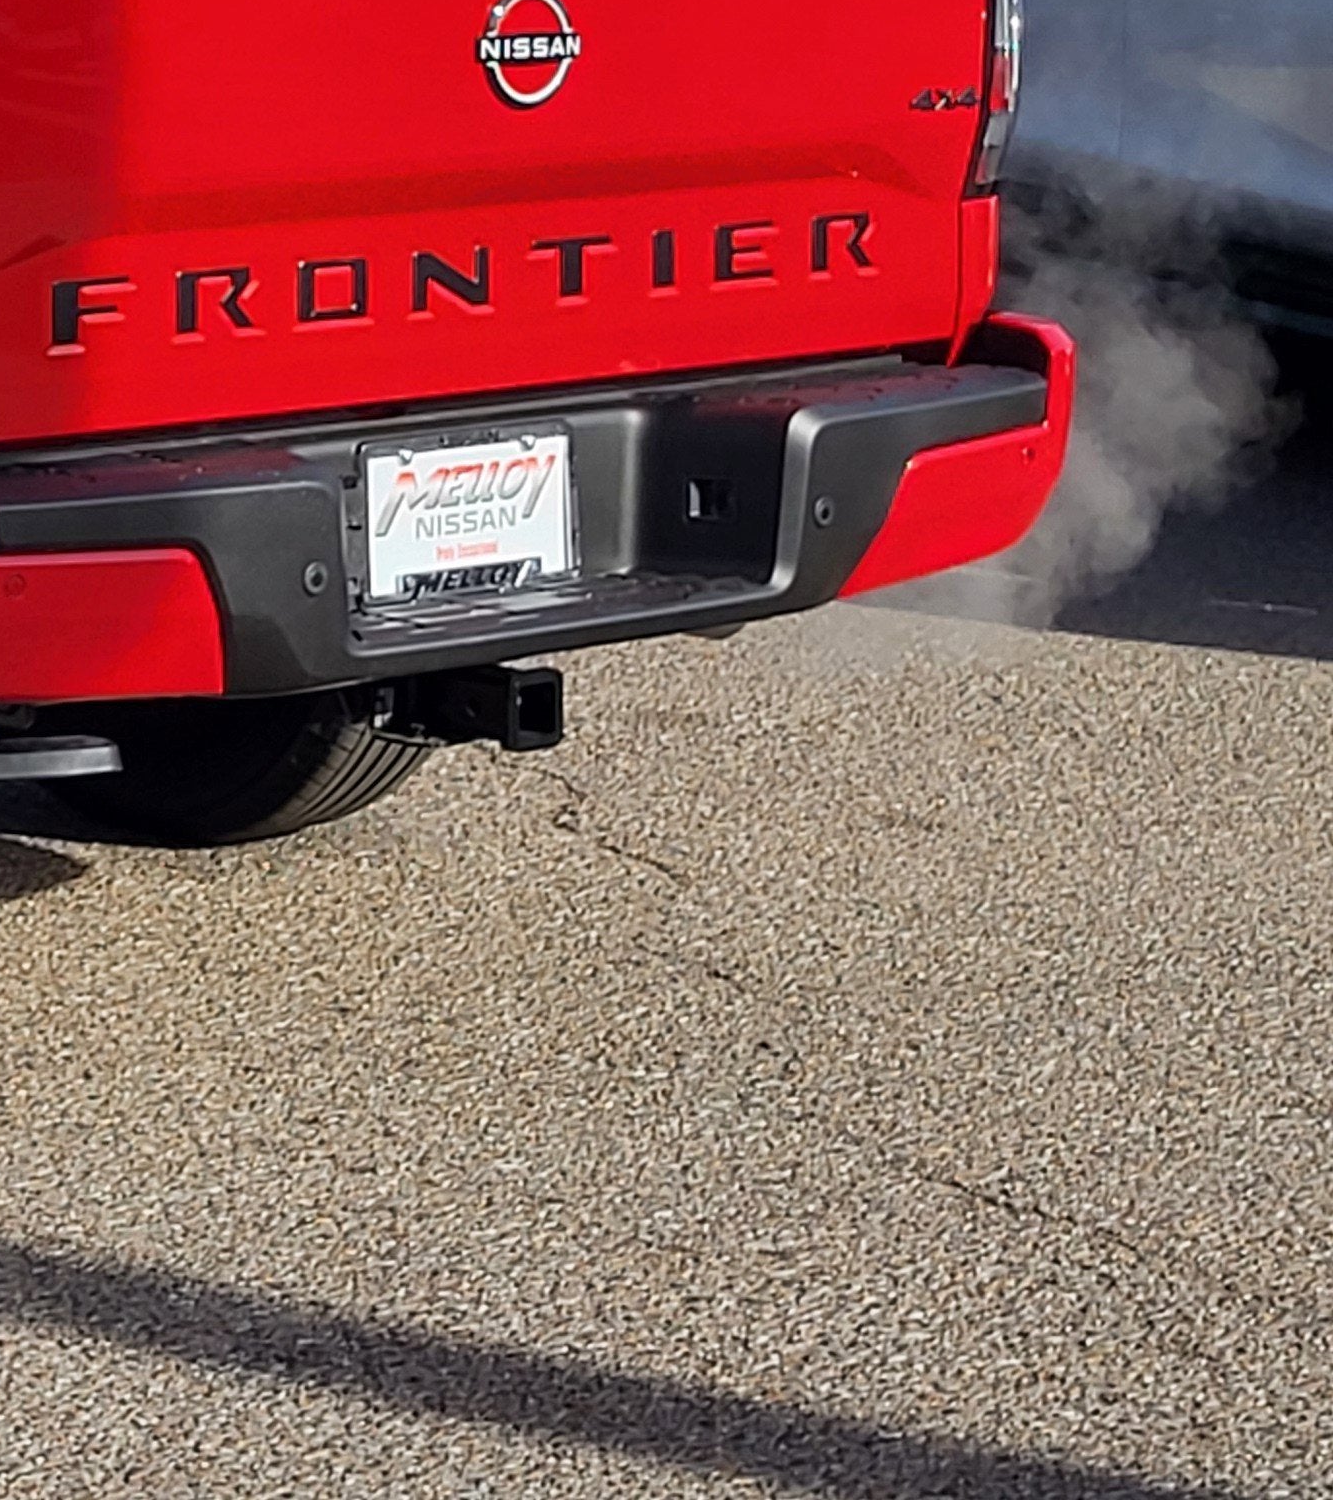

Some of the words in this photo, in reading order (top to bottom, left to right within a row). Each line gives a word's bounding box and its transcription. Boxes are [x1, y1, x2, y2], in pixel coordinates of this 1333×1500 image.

[479, 35, 581, 60] NISSAN
[47, 210, 877, 352] FRONTIER
[416, 505, 517, 539] NISSAN
